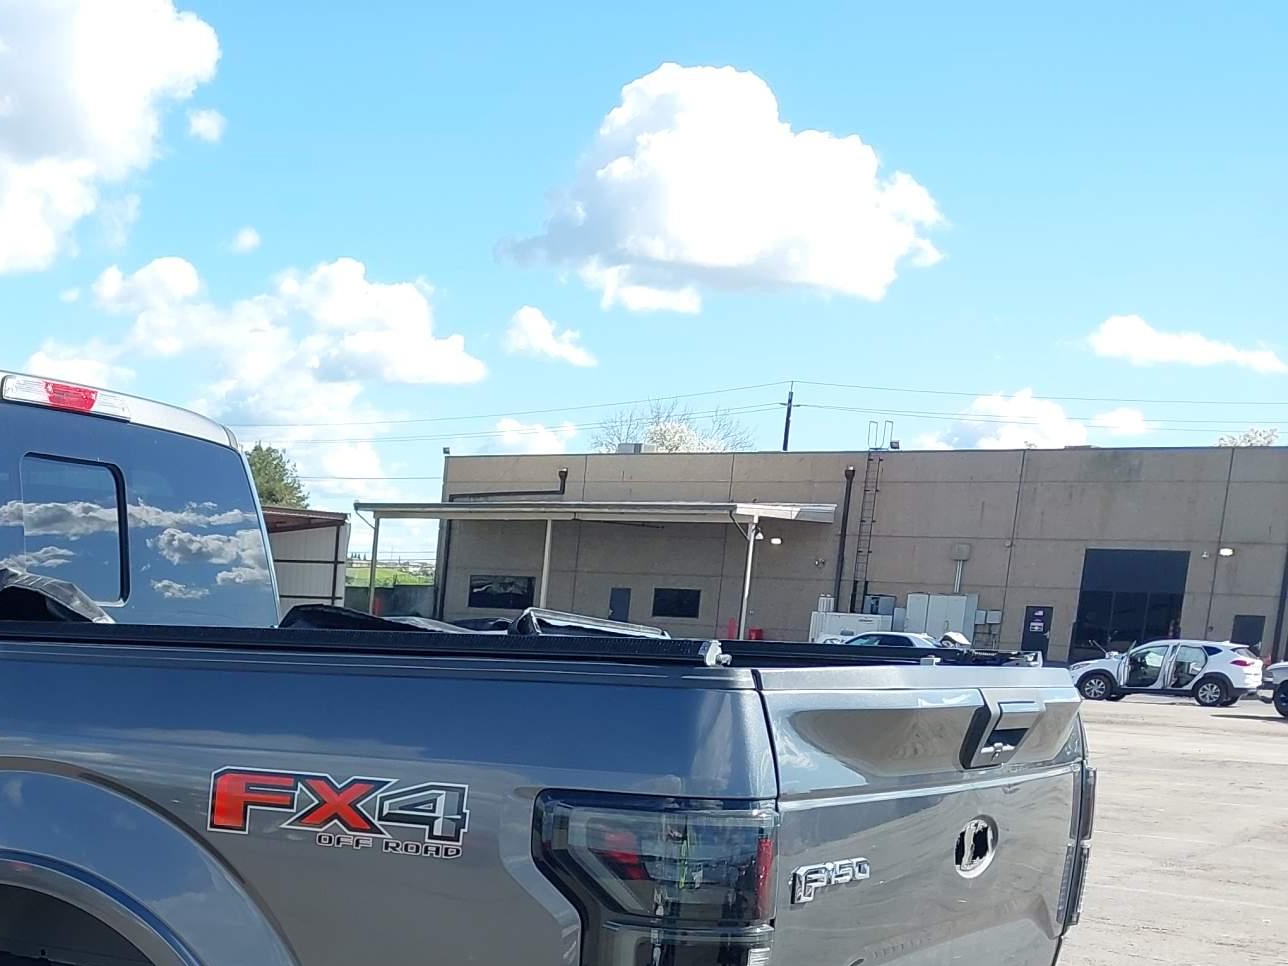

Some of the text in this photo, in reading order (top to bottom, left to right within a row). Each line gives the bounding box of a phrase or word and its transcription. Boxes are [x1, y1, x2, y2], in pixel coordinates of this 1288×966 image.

[207, 766, 470, 845] FX4
[316, 832, 463, 859] OFF ROAD
